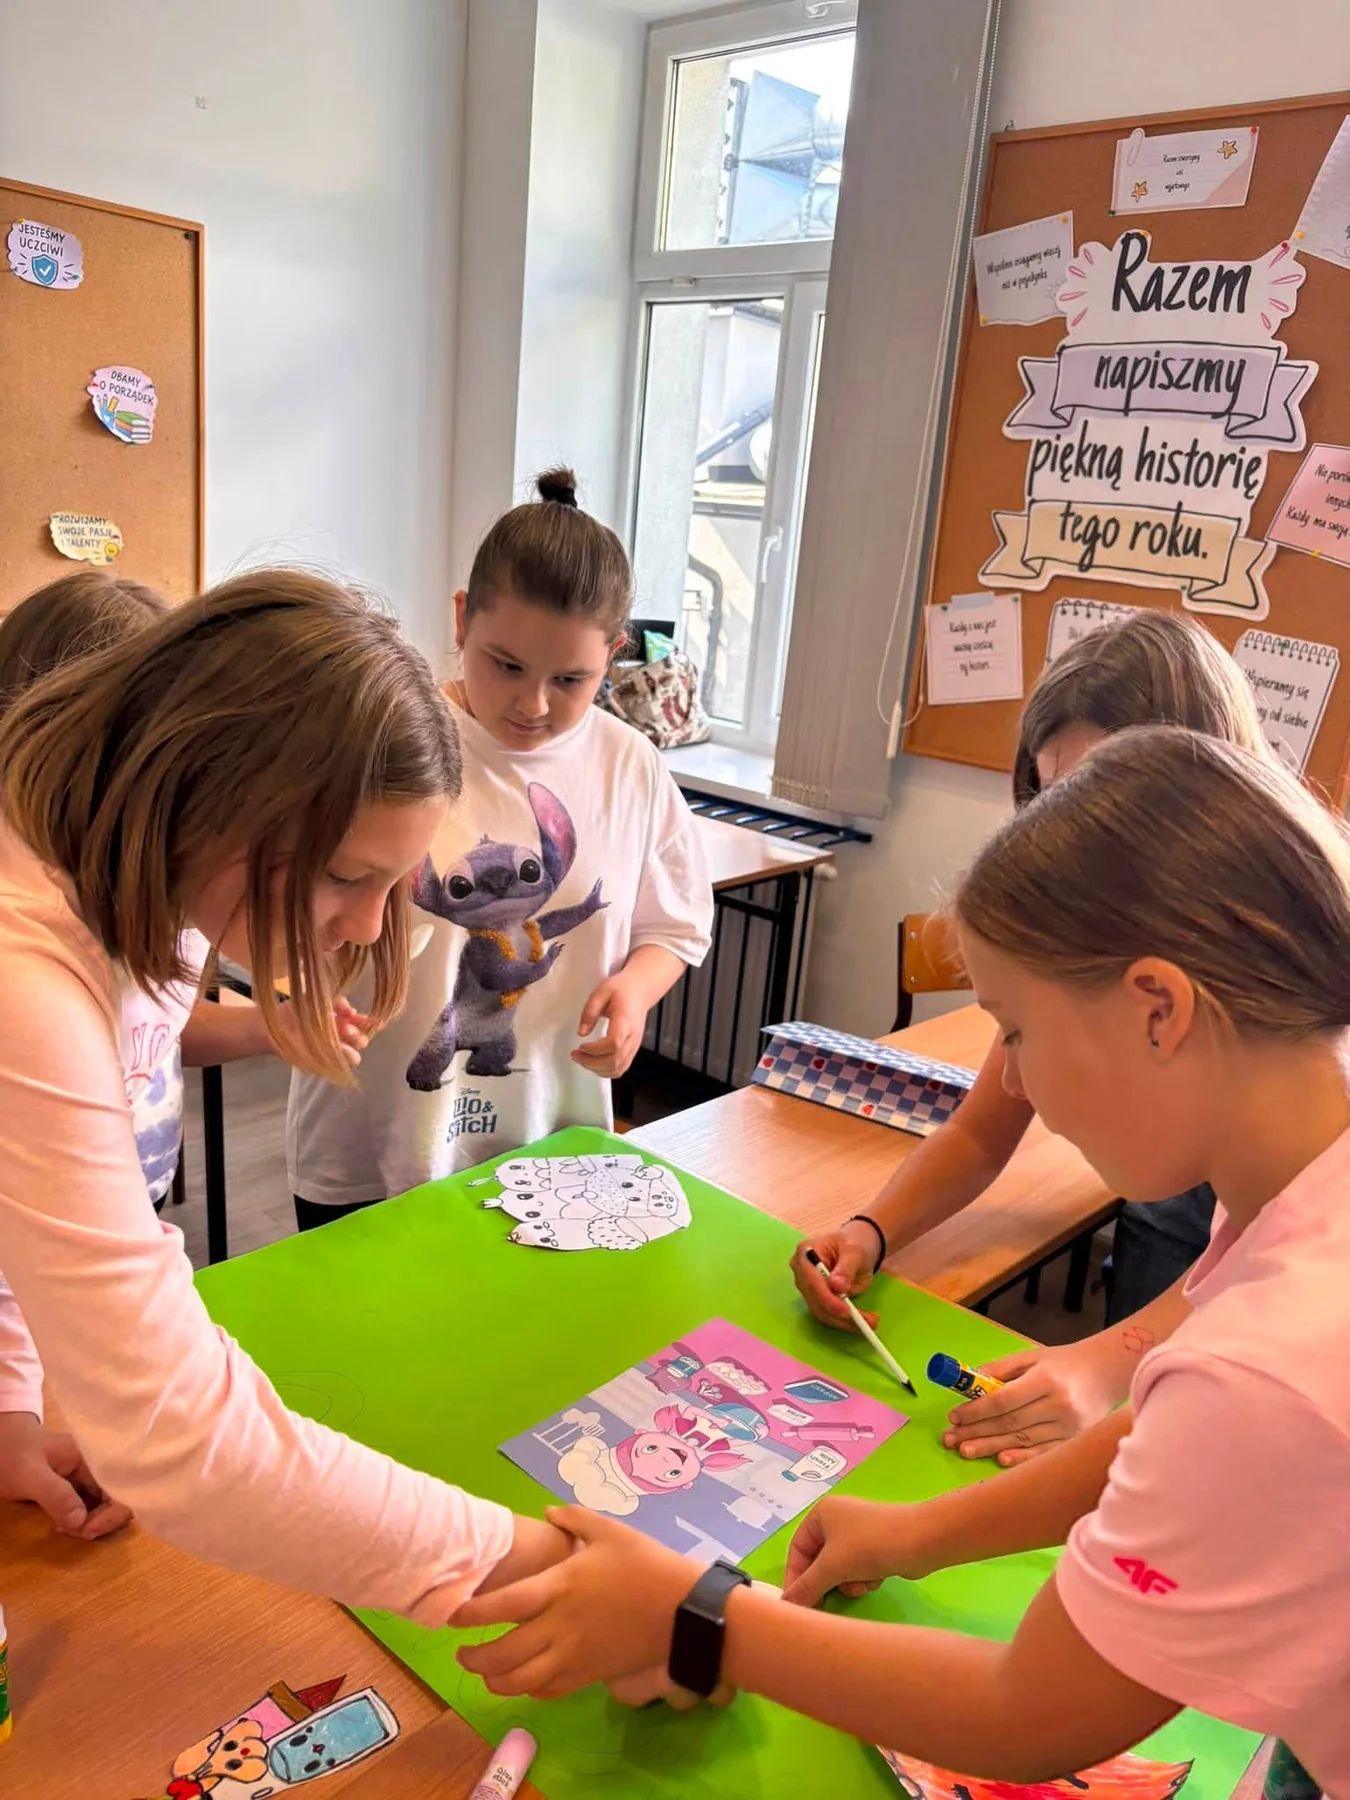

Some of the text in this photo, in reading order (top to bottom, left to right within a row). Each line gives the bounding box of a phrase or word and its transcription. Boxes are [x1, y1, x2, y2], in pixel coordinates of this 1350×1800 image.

[19, 224, 66, 244] JESTEŚMY
[19, 237, 64, 257] UCZCIWI
[1112, 232, 1252, 313] Razem
[111, 370, 141, 388] DBAMY
[1094, 351, 1246, 418] napiszmy
[99, 380, 155, 406] O PORZĄDEK
[1027, 420, 1263, 500] piękną historię
[1060, 501, 1209, 573] tego roku.
[1296, 685, 1310, 701] się
[1284, 711, 1309, 729] siebie
[1113, 1556, 1178, 1595] 4F
